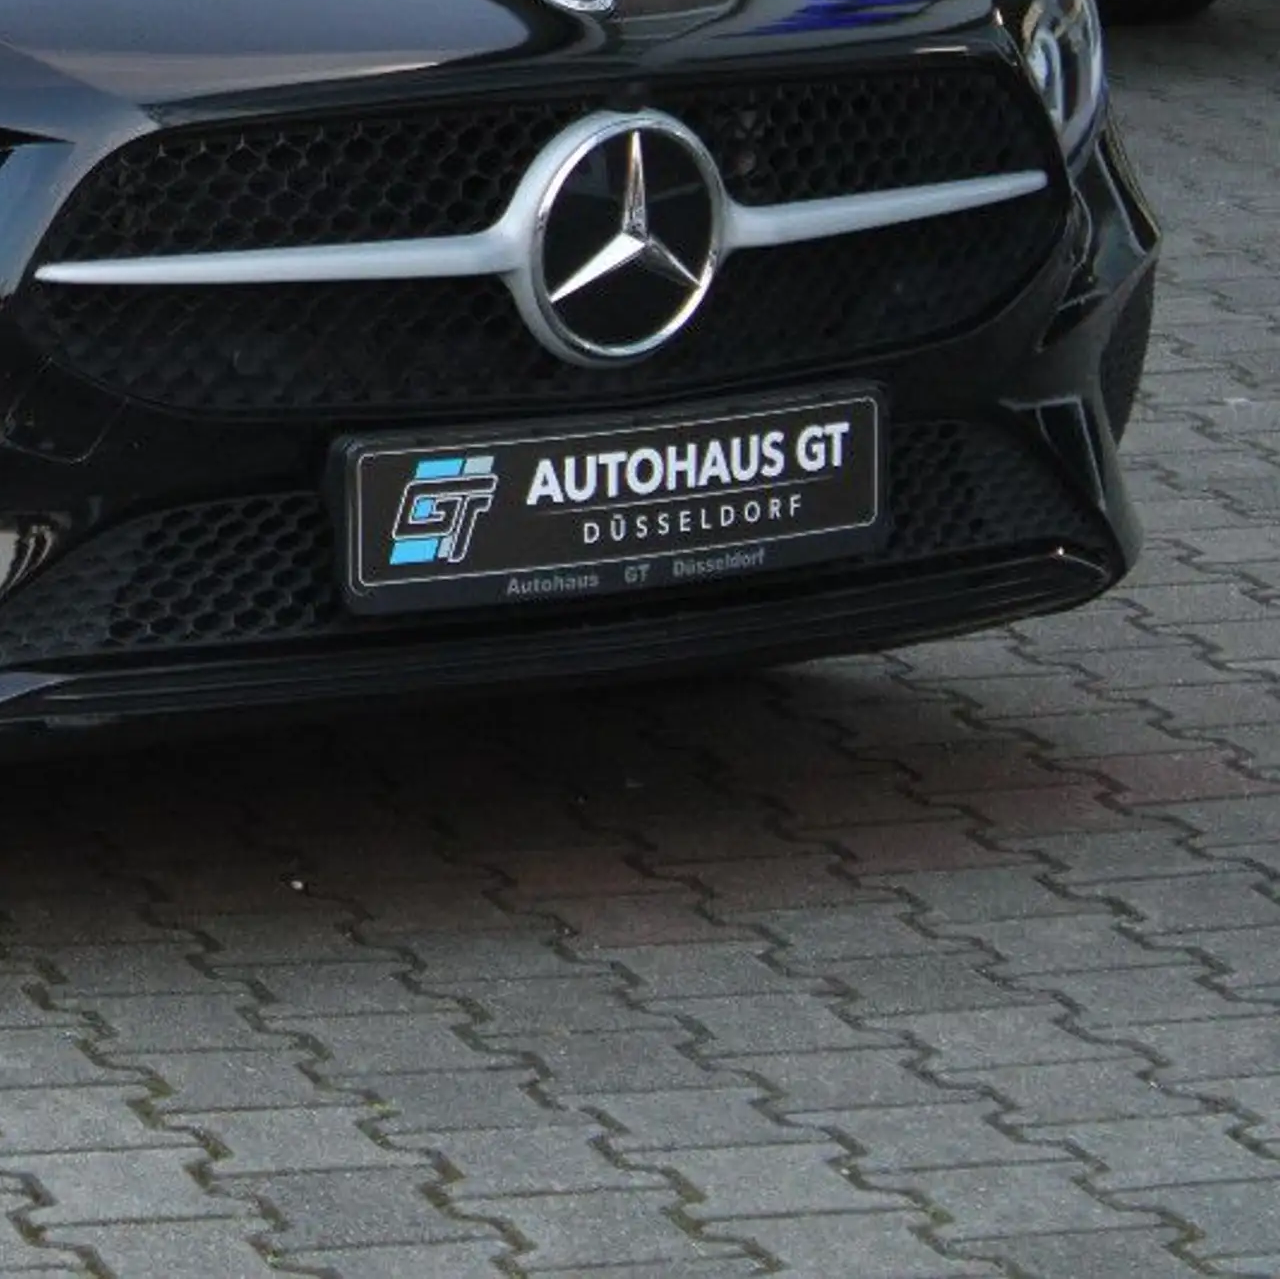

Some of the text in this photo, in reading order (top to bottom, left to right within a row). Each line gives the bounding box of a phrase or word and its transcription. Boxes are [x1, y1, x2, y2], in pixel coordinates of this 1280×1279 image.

[526, 422, 850, 505] AUTOHAUS GT
[583, 493, 802, 544] DÜSSELDORF
[506, 547, 765, 596] Autohaus GT Düsseldorf
